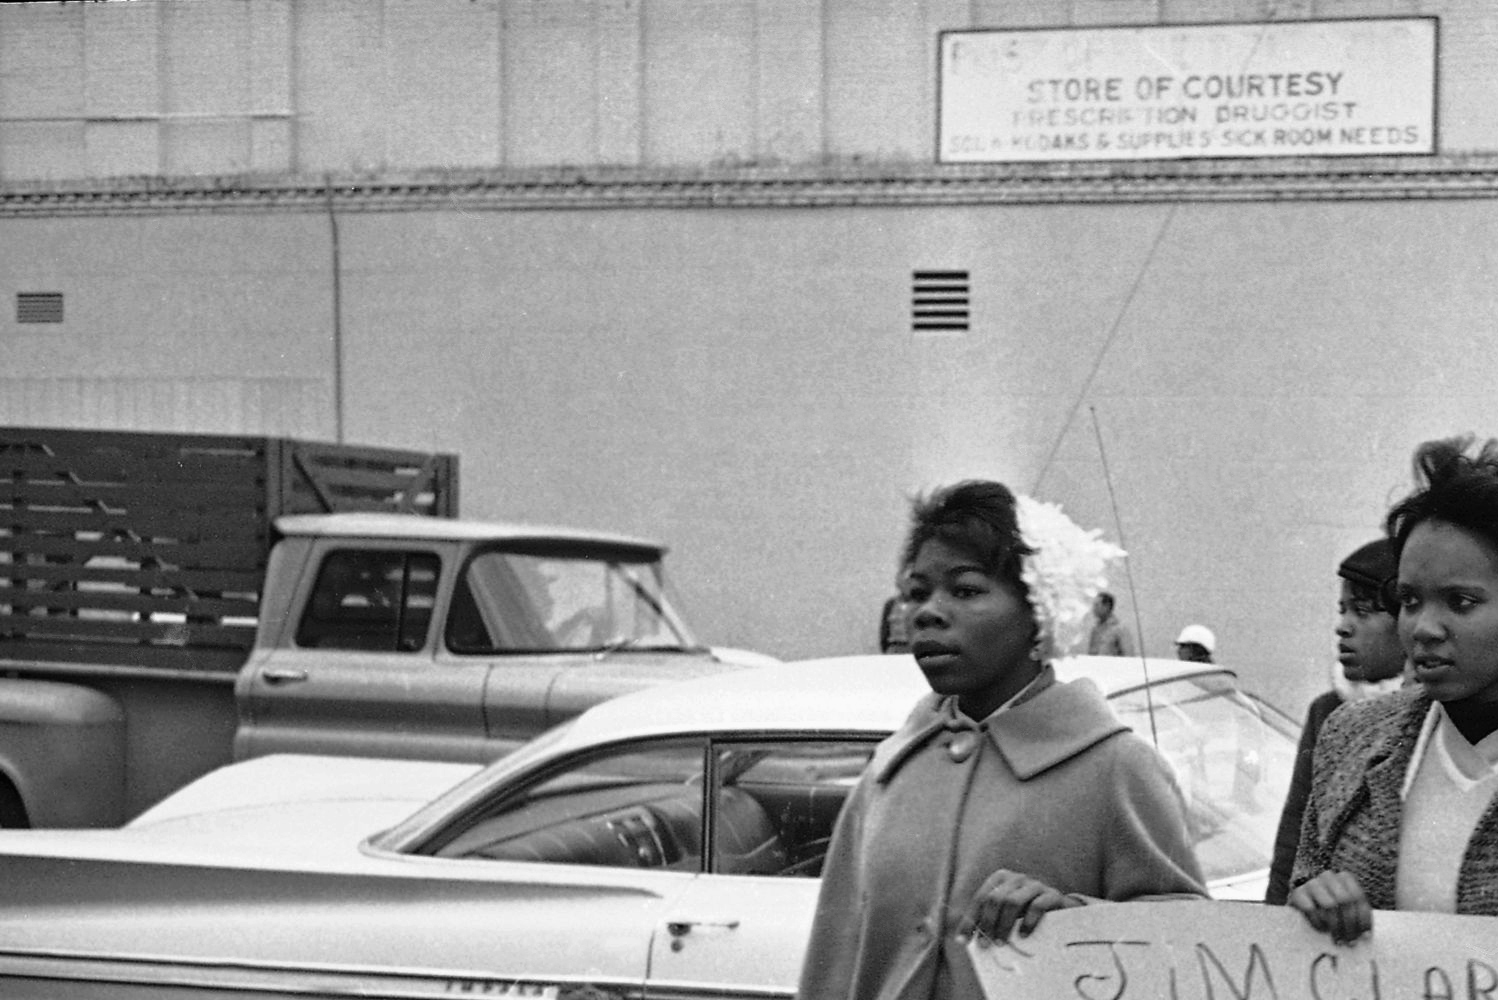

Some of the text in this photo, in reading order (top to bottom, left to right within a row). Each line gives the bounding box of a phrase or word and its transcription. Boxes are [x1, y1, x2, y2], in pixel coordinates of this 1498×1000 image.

[1027, 71, 1343, 103] STORE OF COURTESY
[1215, 101, 1357, 123] DRUGGIST
[1117, 130, 1211, 150] SUPPLIES
[1273, 128, 1332, 147] ROOM
[1340, 125, 1420, 145] NEEDS
